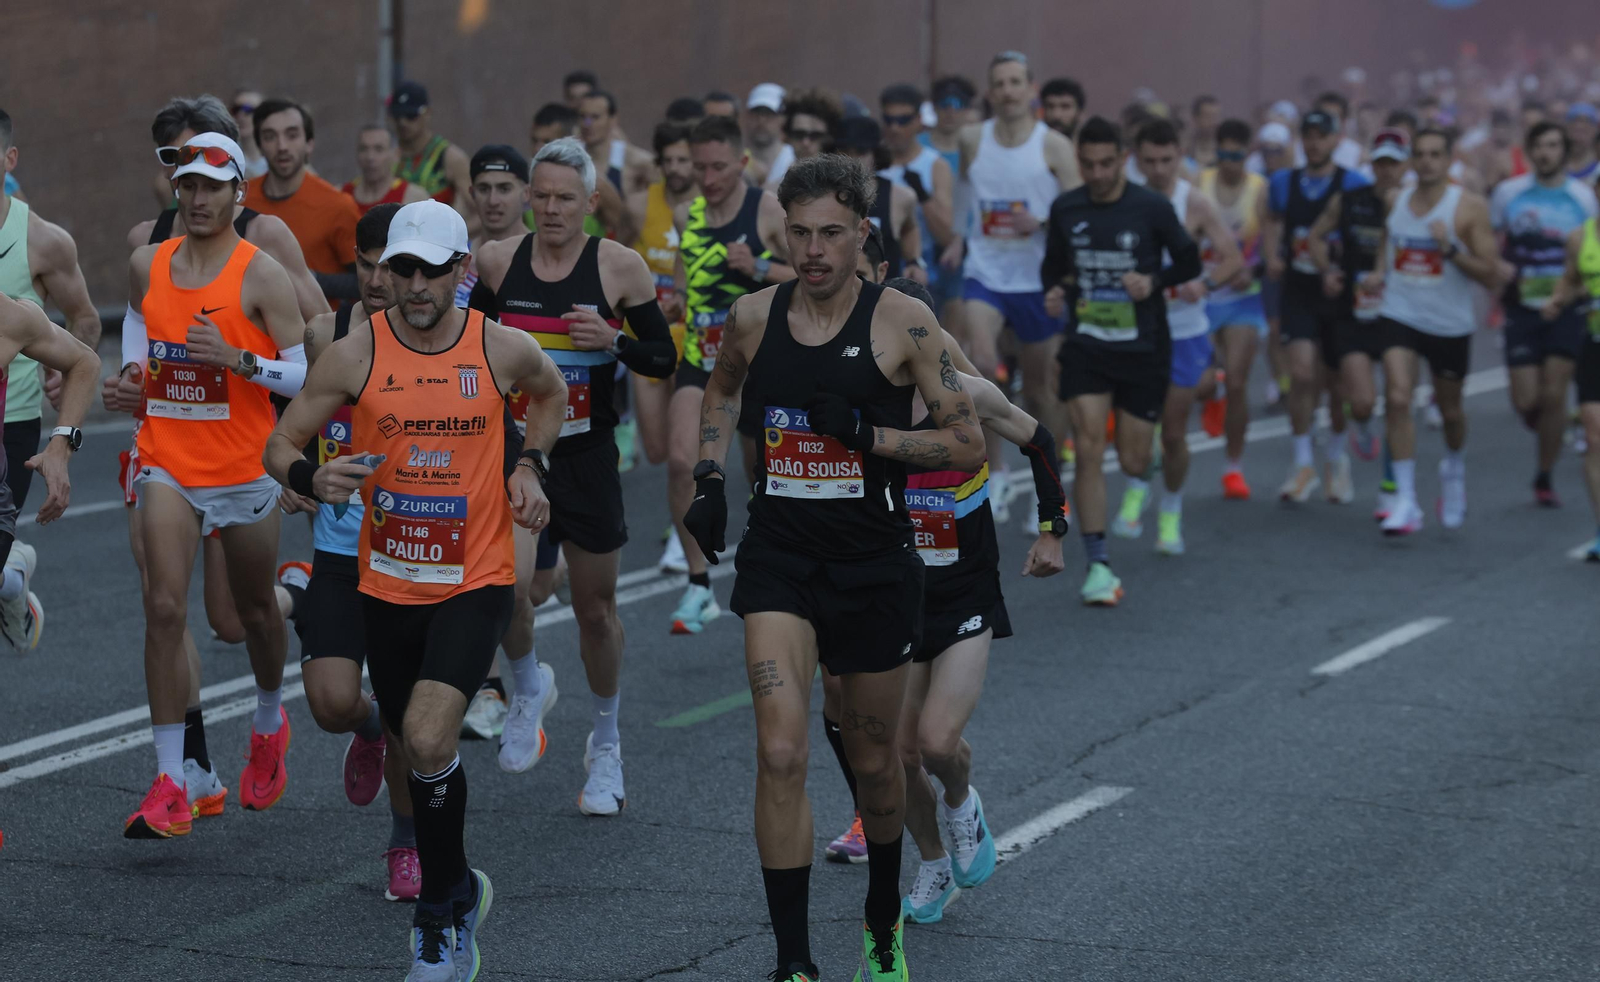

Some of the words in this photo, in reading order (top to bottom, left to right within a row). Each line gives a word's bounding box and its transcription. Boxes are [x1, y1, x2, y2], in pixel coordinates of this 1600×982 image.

[173, 369, 196, 382] 1030
[166, 383, 206, 402] HUGO
[797, 441, 825, 454] 1032
[407, 444, 452, 468] 2eme
[395, 468, 418, 479] Maria
[421, 470, 429, 479] &
[431, 471, 460, 480] Marina
[767, 457, 804, 477] JOÃO
[808, 461, 863, 478] SOUSA
[400, 499, 455, 513] ZURICH
[904, 494, 944, 507] URICH
[400, 525, 429, 538] 1146
[915, 532, 936, 547] ER
[386, 538, 443, 562] PAULO
